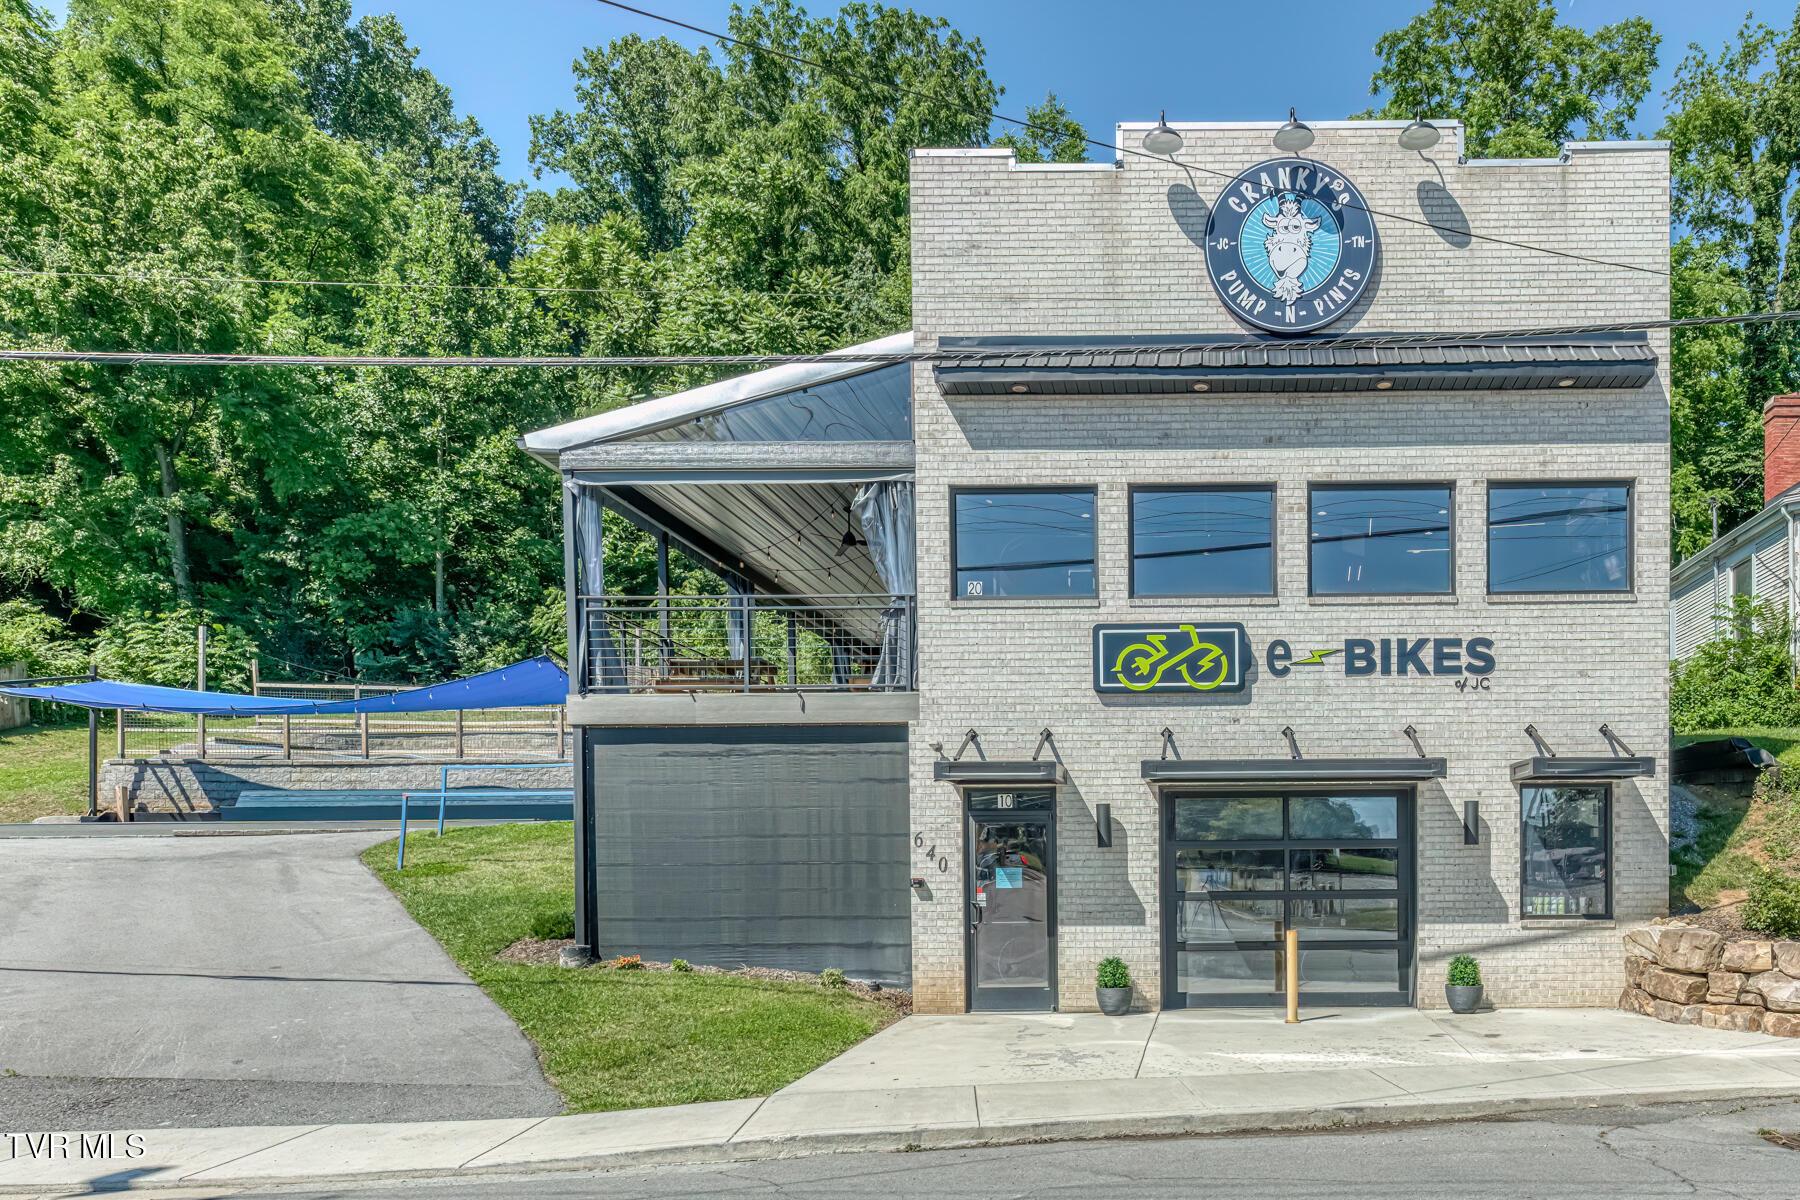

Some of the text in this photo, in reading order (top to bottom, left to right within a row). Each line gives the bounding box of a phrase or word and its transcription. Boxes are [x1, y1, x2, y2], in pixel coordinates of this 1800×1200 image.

[1220, 269, 1266, 316] PUMP
[1313, 268, 1361, 316] PINTS
[968, 582, 982, 595] 20
[1454, 676, 1491, 693] of JC
[999, 794, 1013, 808] 10
[914, 831, 948, 873] 640
